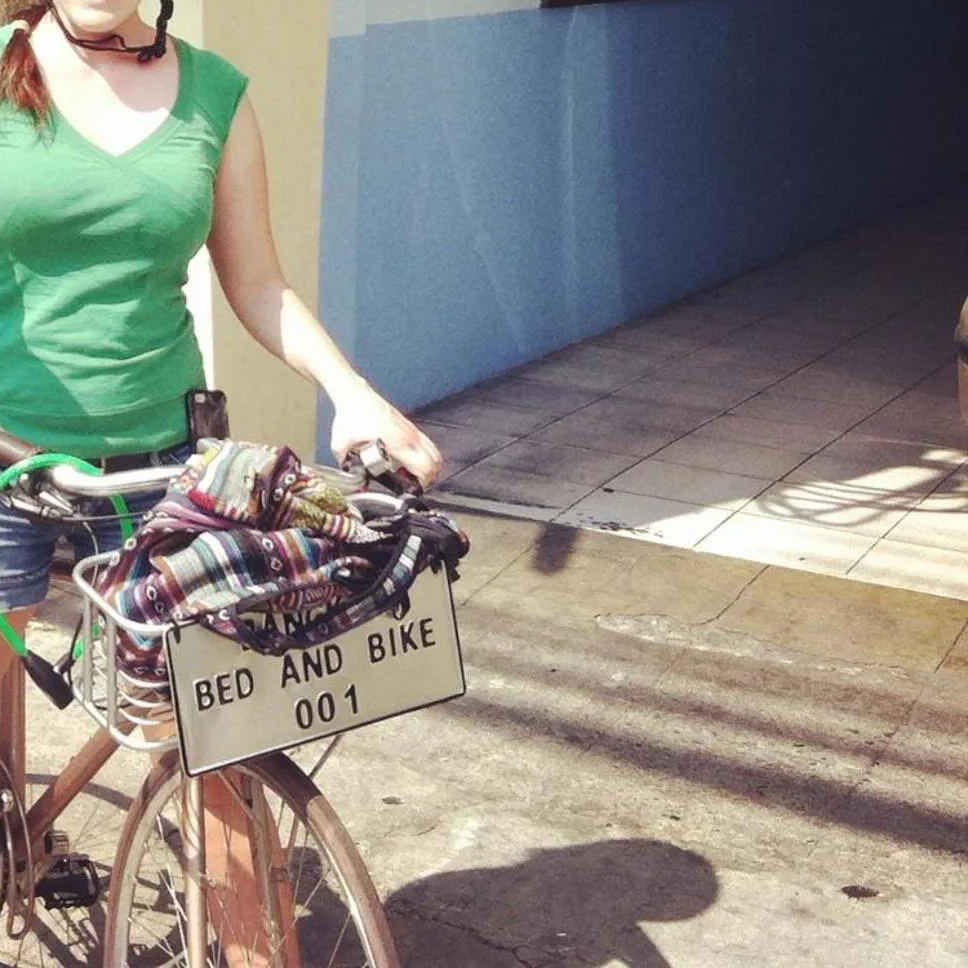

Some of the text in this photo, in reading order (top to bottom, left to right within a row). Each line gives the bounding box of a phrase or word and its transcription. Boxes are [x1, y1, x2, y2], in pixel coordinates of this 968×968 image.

[194, 667, 254, 712] BED
[281, 643, 343, 688] AND
[367, 617, 437, 664] BIKE
[295, 683, 359, 730] 001
